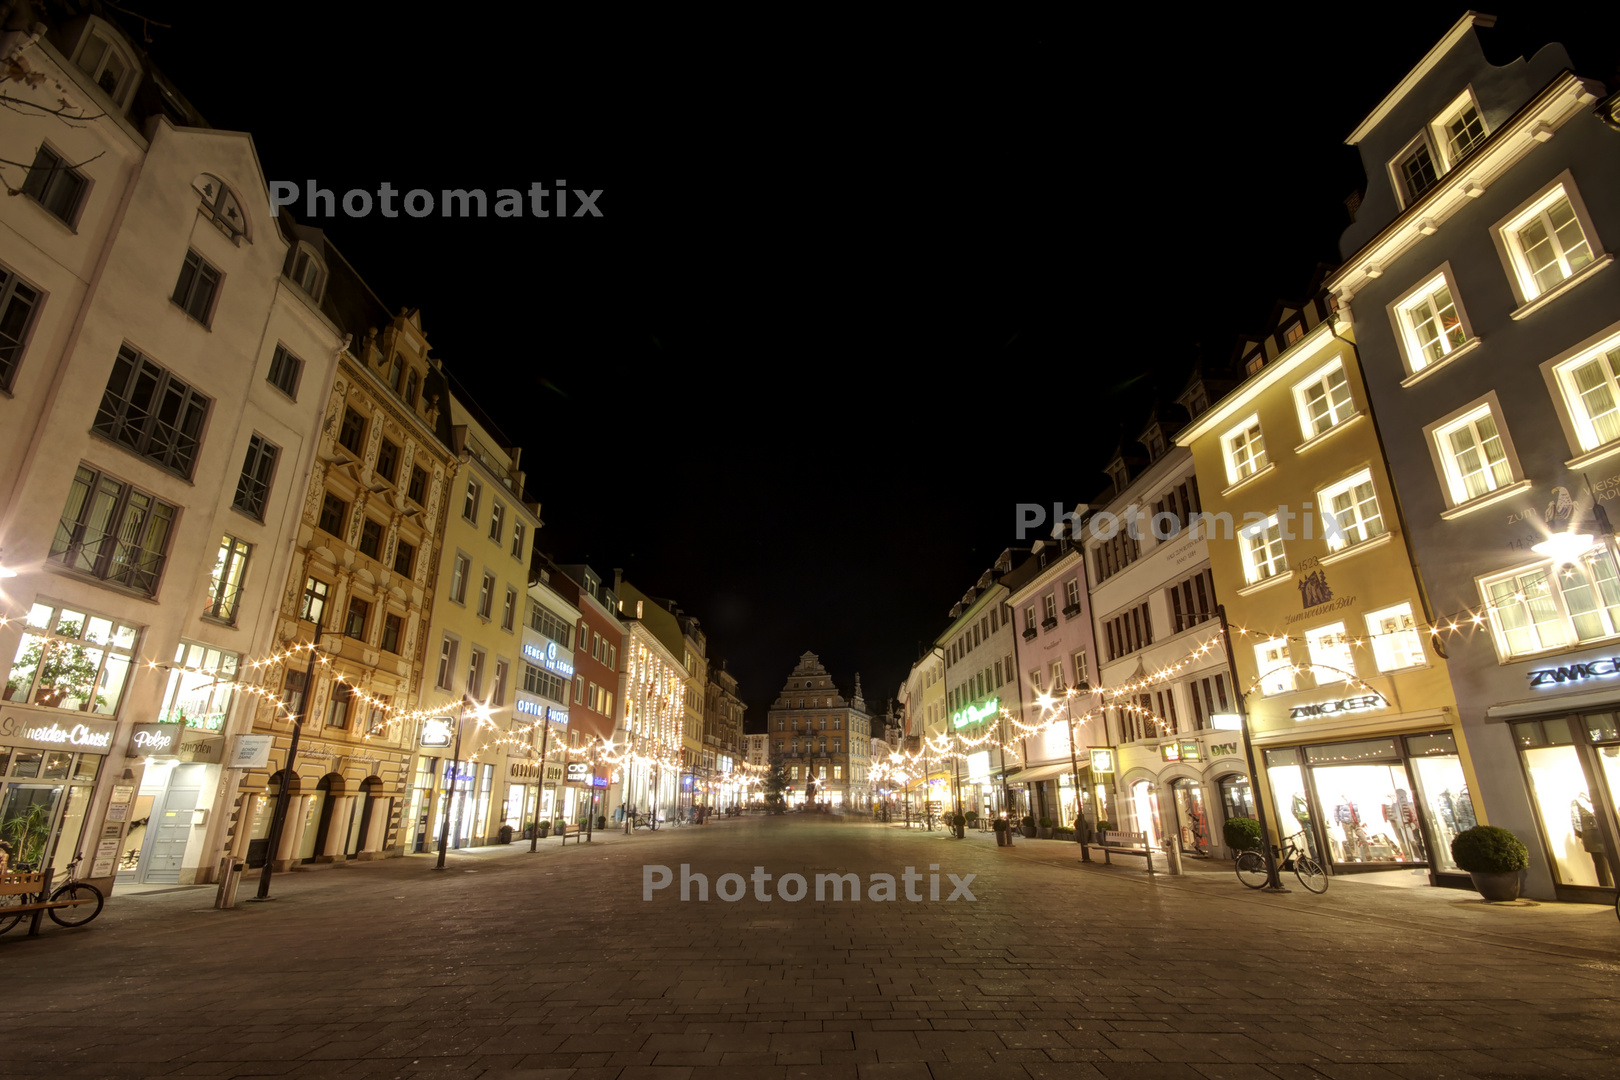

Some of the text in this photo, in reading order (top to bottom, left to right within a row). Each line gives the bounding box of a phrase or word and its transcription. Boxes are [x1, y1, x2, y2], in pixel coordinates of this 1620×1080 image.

[1297, 556, 1319, 572] 1523
[1335, 595, 1357, 610] Bär
[524, 644, 545, 660] SEHEN
[555, 660, 574, 675] LEBEN
[517, 700, 543, 716] OPTIK
[1289, 695, 1380, 719] ZWICKER
[133, 730, 171, 750] Pelze
[1211, 742, 1238, 757] DKV
